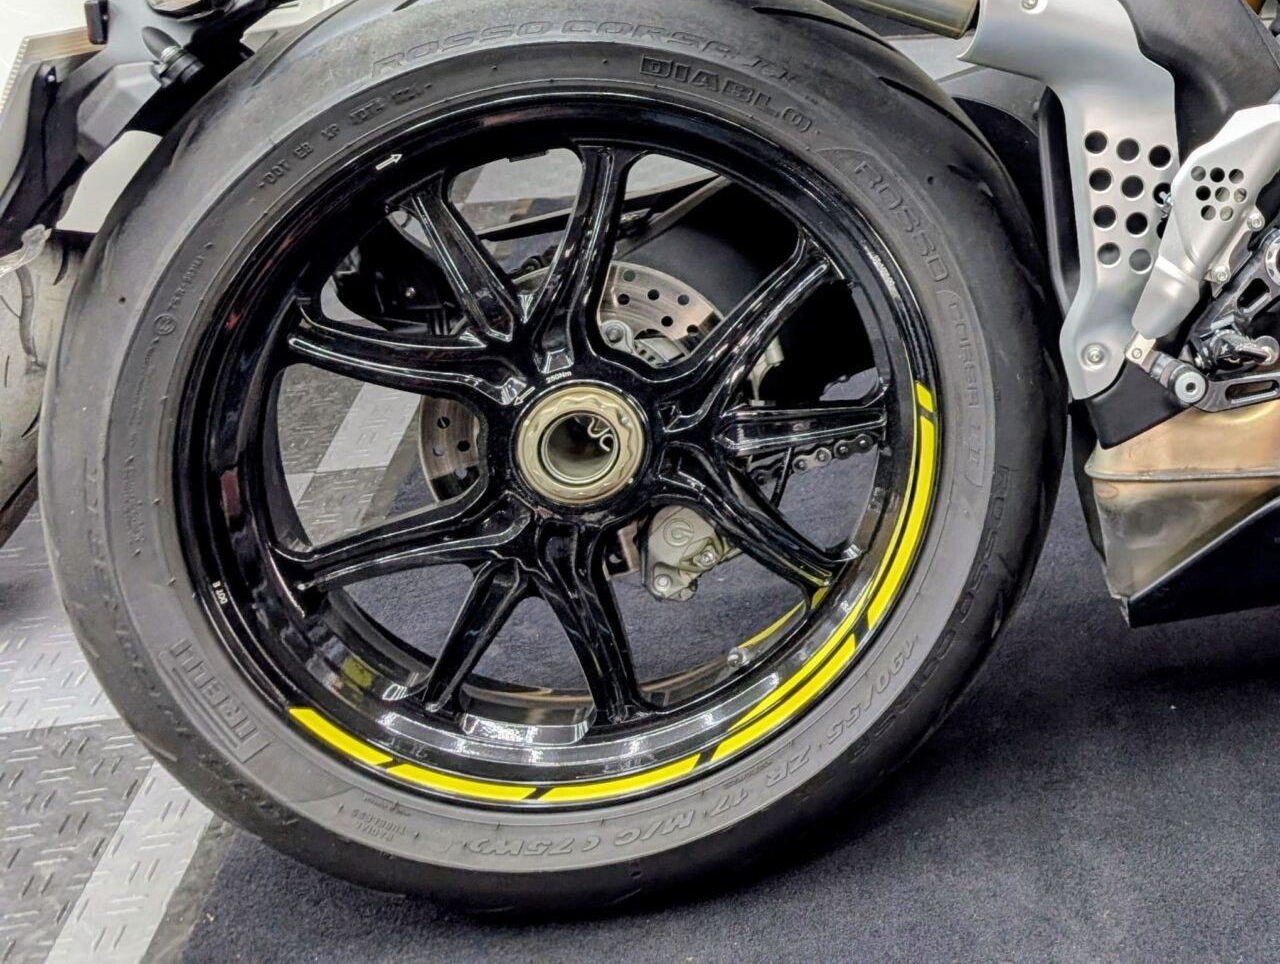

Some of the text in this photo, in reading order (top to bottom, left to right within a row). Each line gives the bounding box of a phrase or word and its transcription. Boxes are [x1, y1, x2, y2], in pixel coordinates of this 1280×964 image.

[371, 19, 553, 78] ROSSO
[560, 19, 741, 59] CORSA
[639, 54, 815, 134] DIABLO
[853, 160, 949, 284] ROSSO
[215, 587, 229, 605] DOT
[157, 636, 272, 765] PIRELLI
[827, 635, 919, 745] 190/55
[765, 745, 812, 787] ZR
[614, 808, 695, 847] M/C
[709, 789, 749, 819] 17
